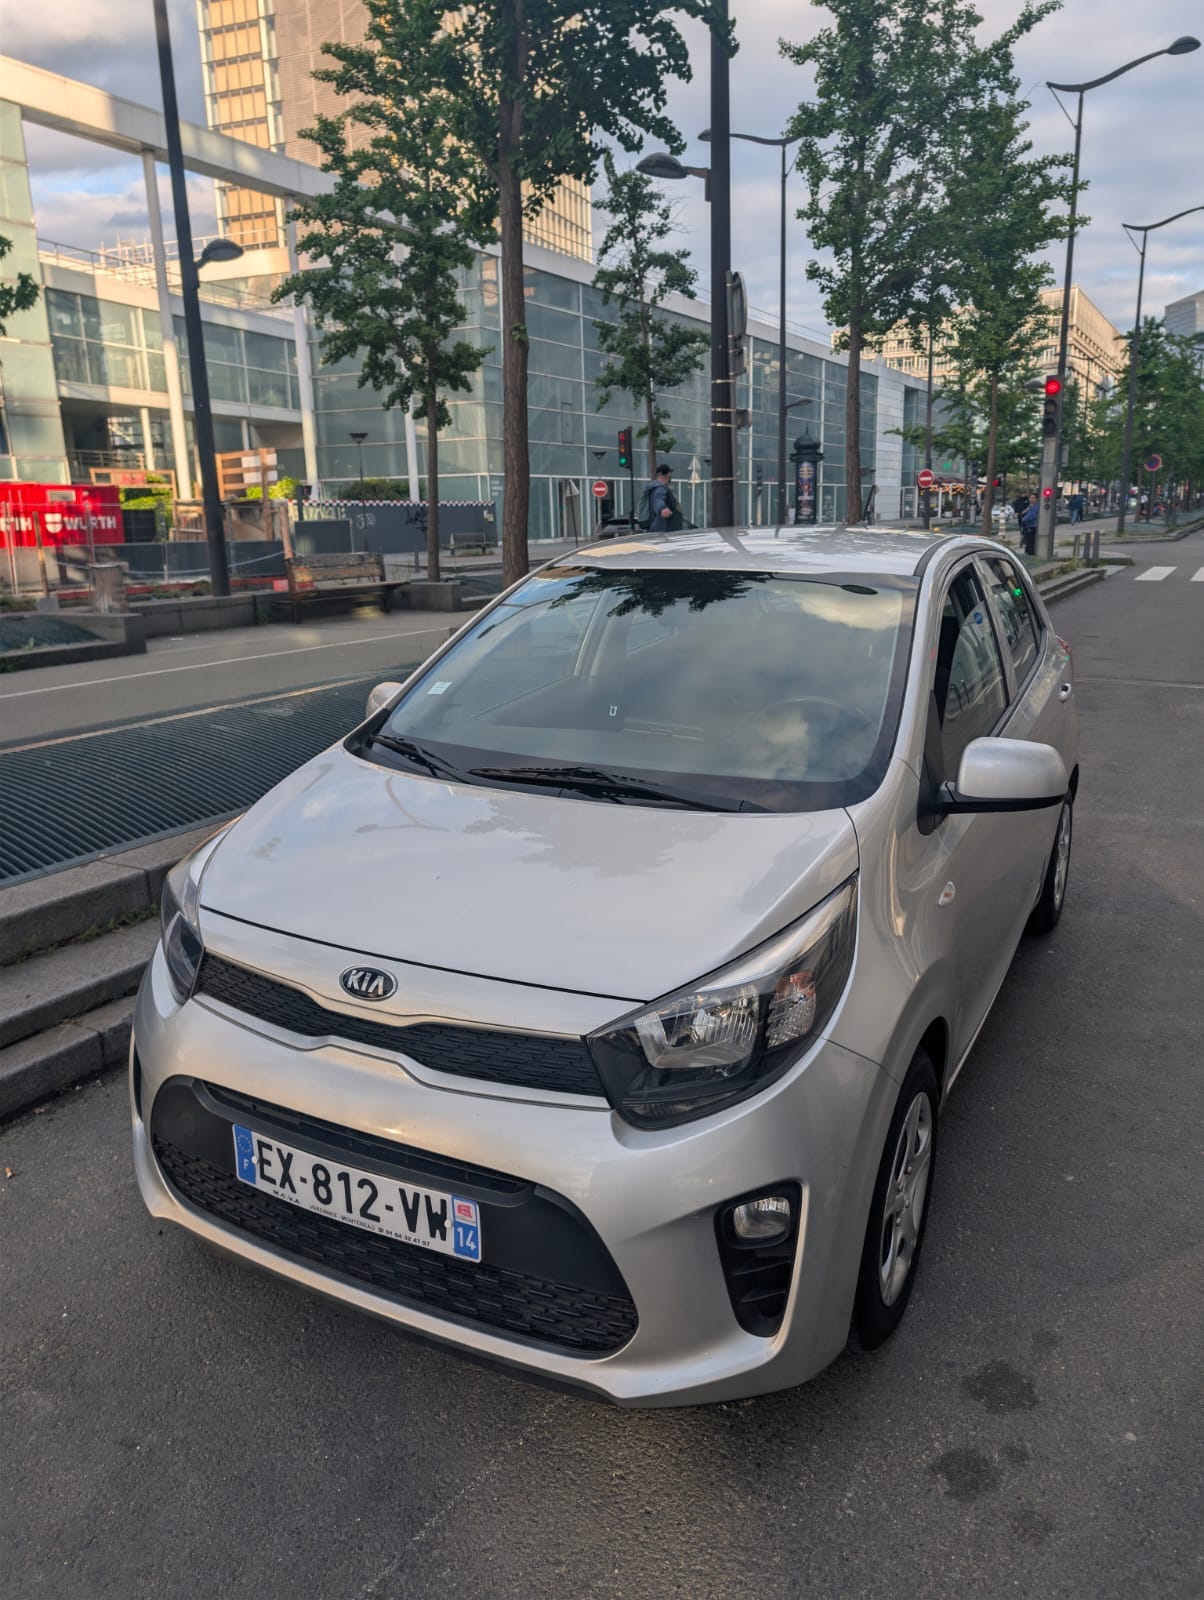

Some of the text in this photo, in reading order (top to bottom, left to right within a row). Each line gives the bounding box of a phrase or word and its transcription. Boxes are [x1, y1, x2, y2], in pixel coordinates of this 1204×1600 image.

[347, 969, 384, 995] KIA
[243, 1158, 250, 1170] F
[256, 1139, 448, 1242] EX-812-VW
[457, 1226, 477, 1251] 14
